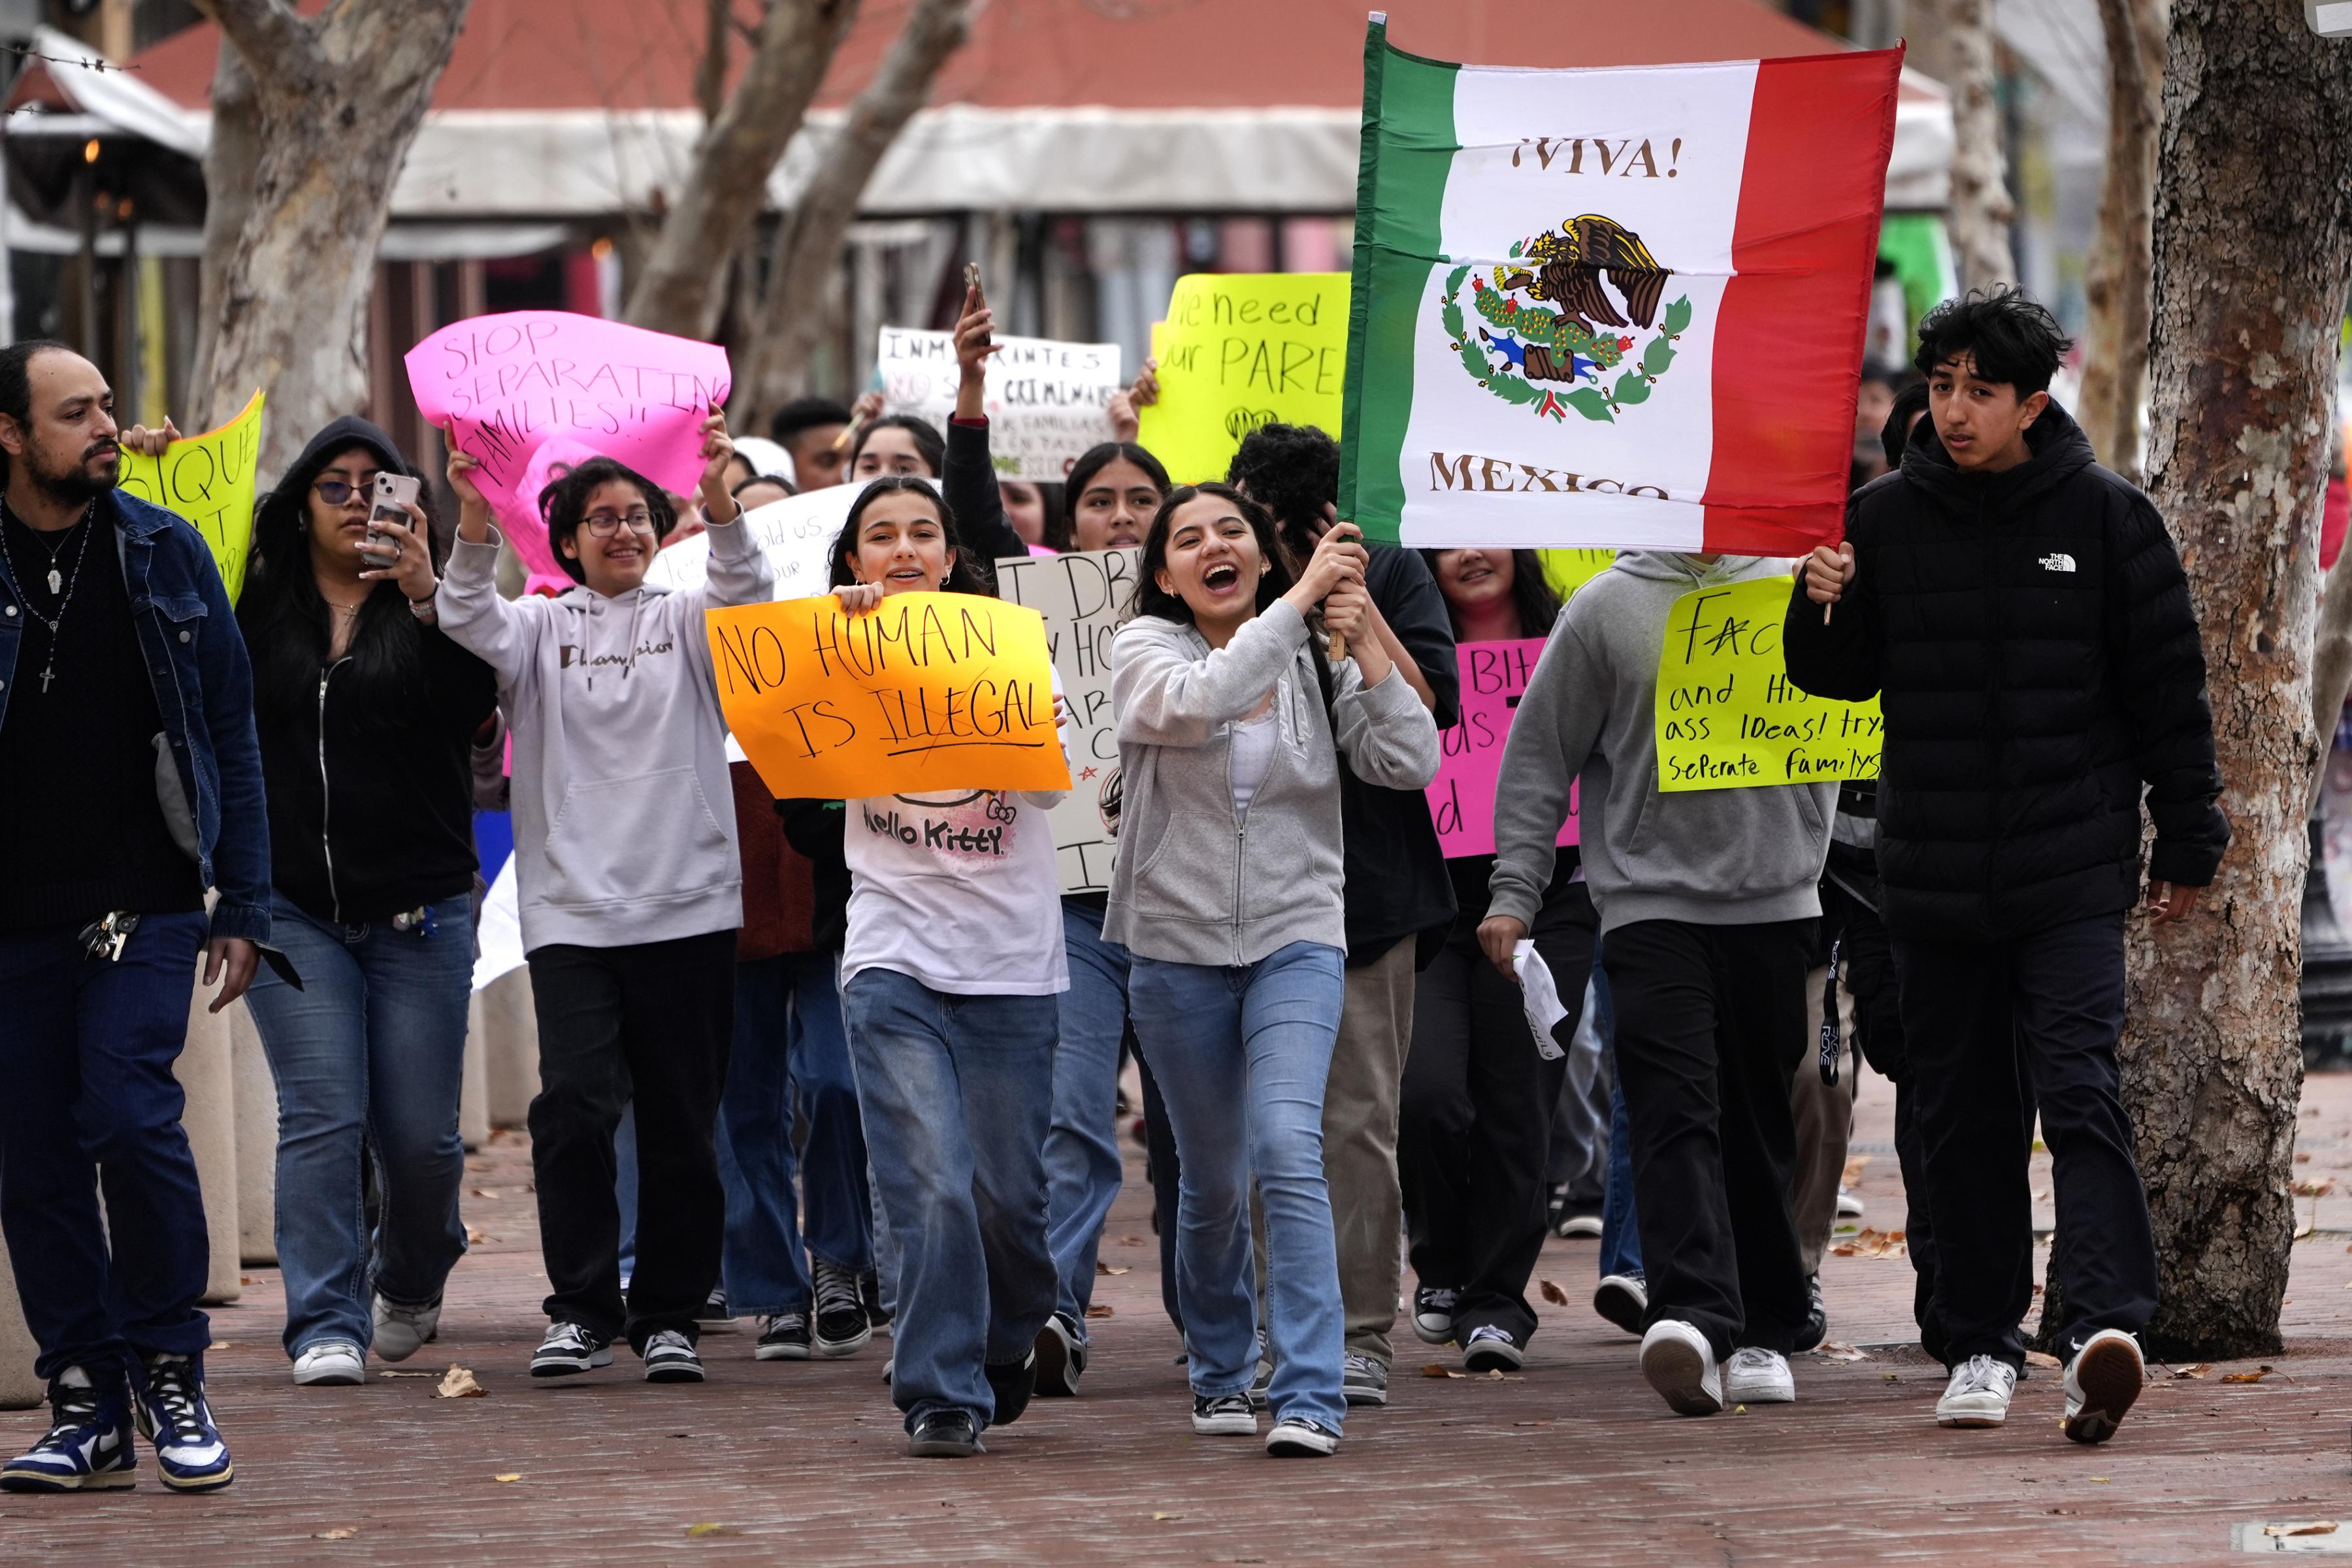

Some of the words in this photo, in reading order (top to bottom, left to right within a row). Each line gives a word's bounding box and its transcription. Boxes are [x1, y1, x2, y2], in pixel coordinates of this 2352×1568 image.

[1512, 137, 1682, 178] ¡VIVA!
[1213, 292, 1320, 326] need
[444, 320, 558, 380] STOP
[886, 335, 1101, 370] INMRANTES
[1220, 337, 1345, 395] PARE
[462, 397, 645, 487] FAMILIES!!
[717, 625, 785, 694] NO
[813, 604, 996, 680] HUMAN
[1669, 673, 1735, 711] and
[783, 700, 856, 759] IS
[868, 679, 1049, 744] ILLEGAL
[1665, 717, 1710, 742] ass
[862, 803, 917, 845] Hello
[1820, 1025, 1831, 1066] ROVE
